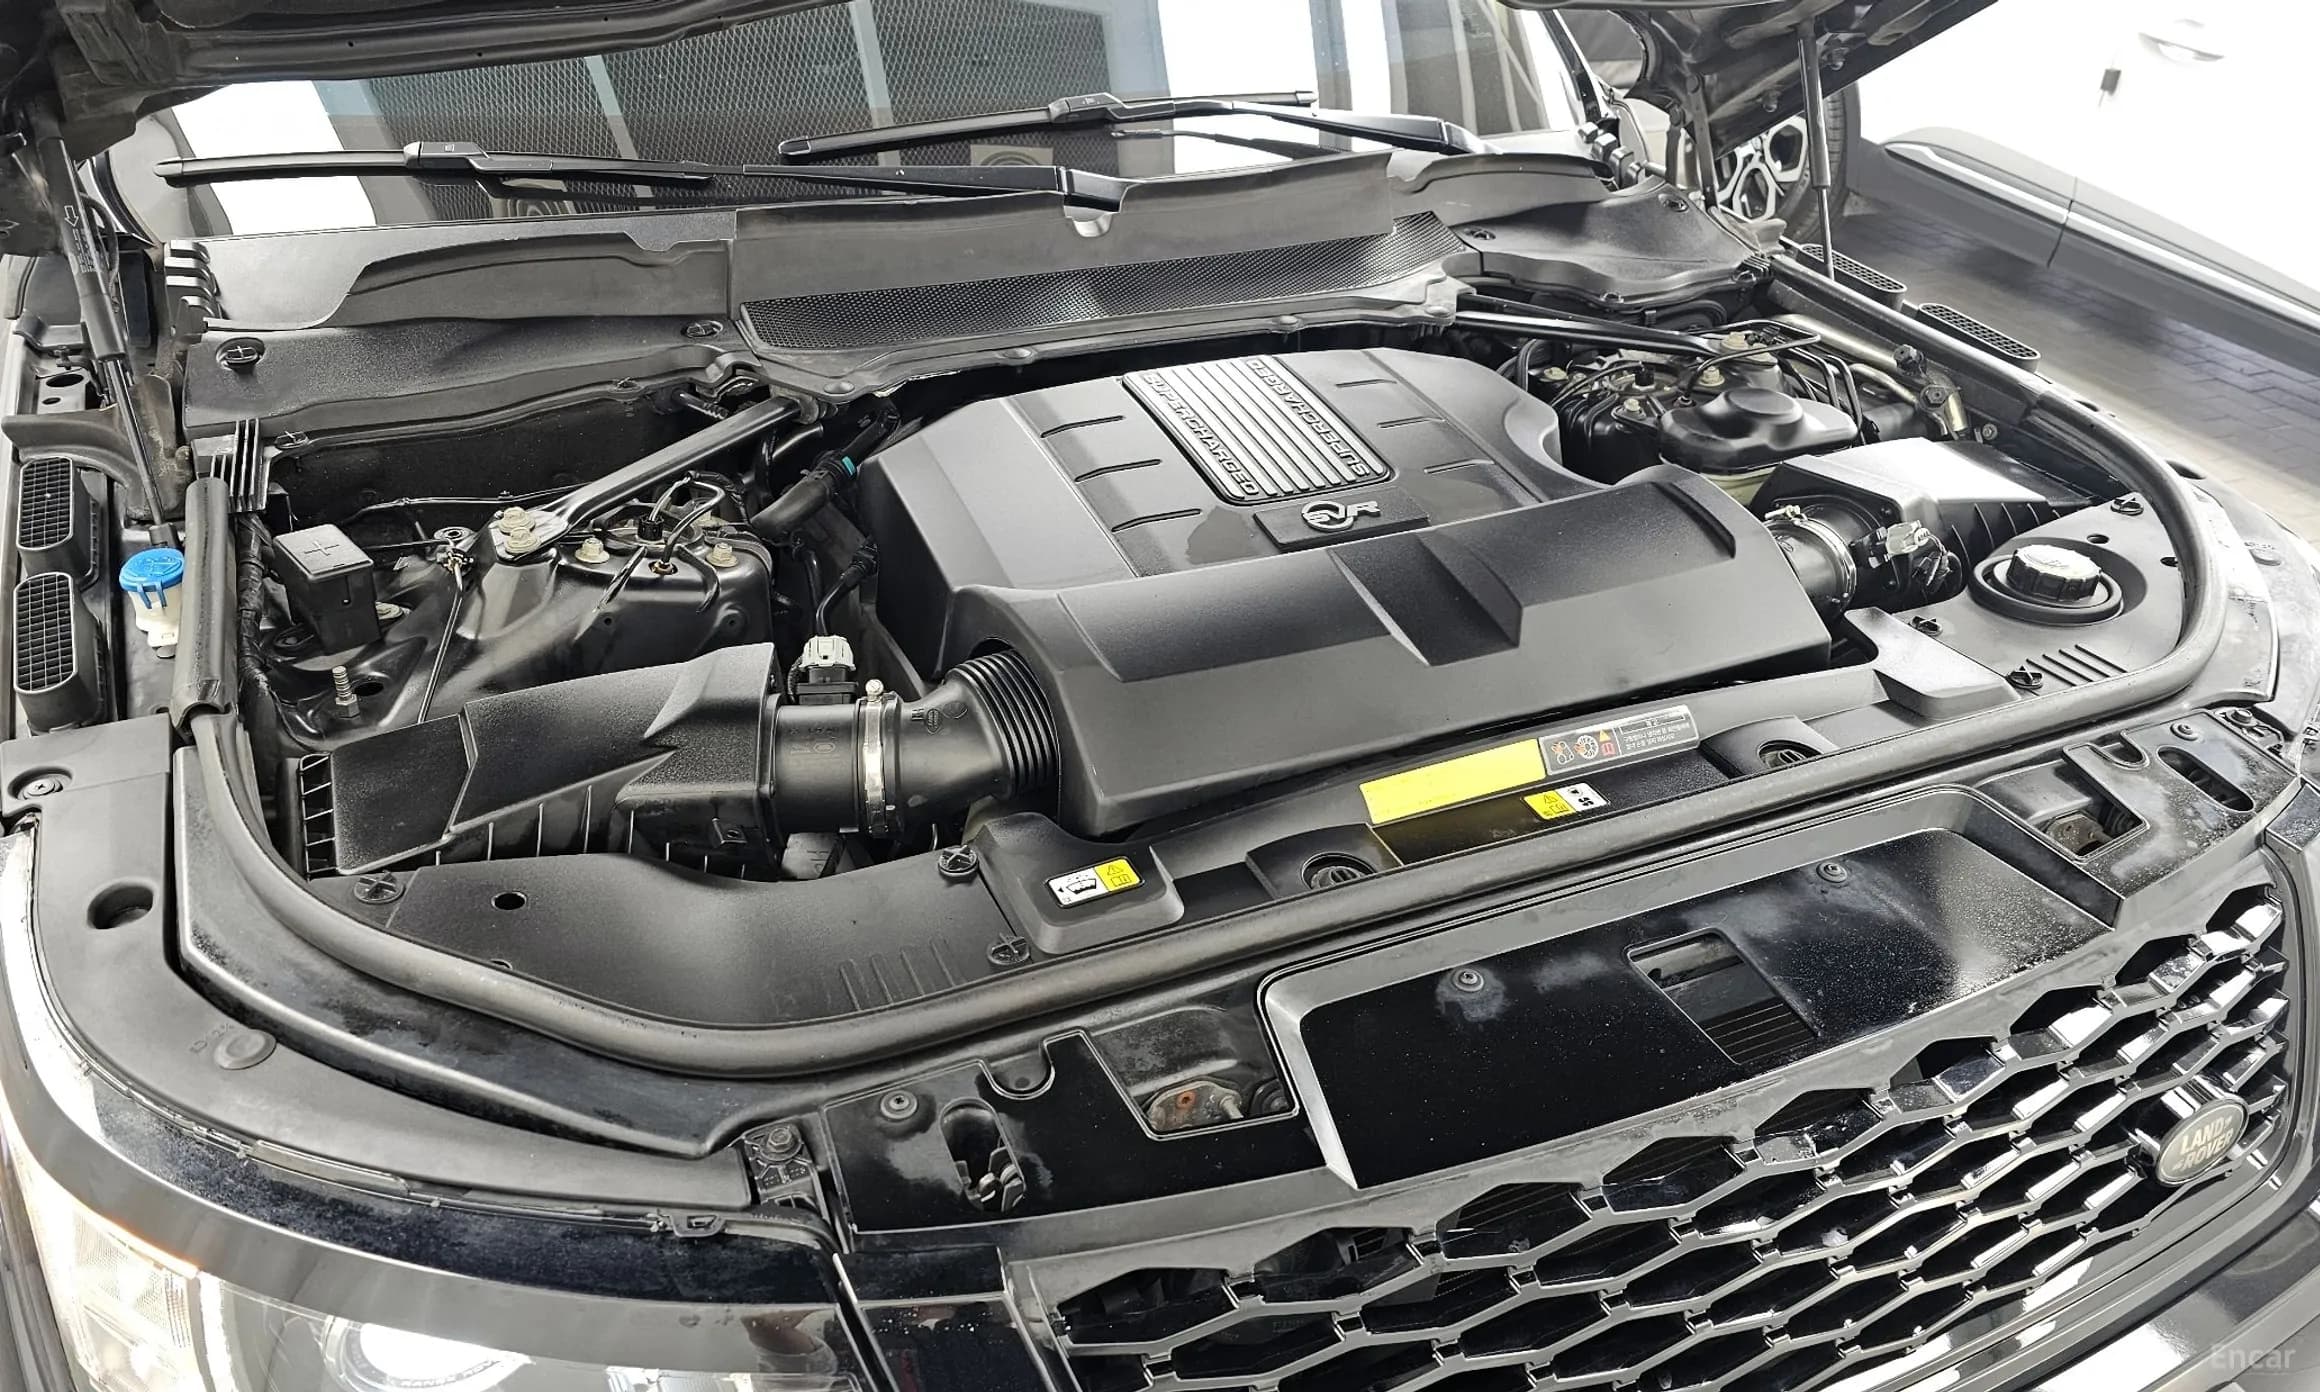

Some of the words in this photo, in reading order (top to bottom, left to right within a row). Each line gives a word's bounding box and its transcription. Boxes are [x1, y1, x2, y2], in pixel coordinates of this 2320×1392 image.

[1143, 372, 1260, 496] SUPERCHARGED
[1245, 357, 1372, 477] SUPERCHARGED
[2180, 1116, 2226, 1154] LAND
[2183, 1127, 2234, 1170] ROVER
